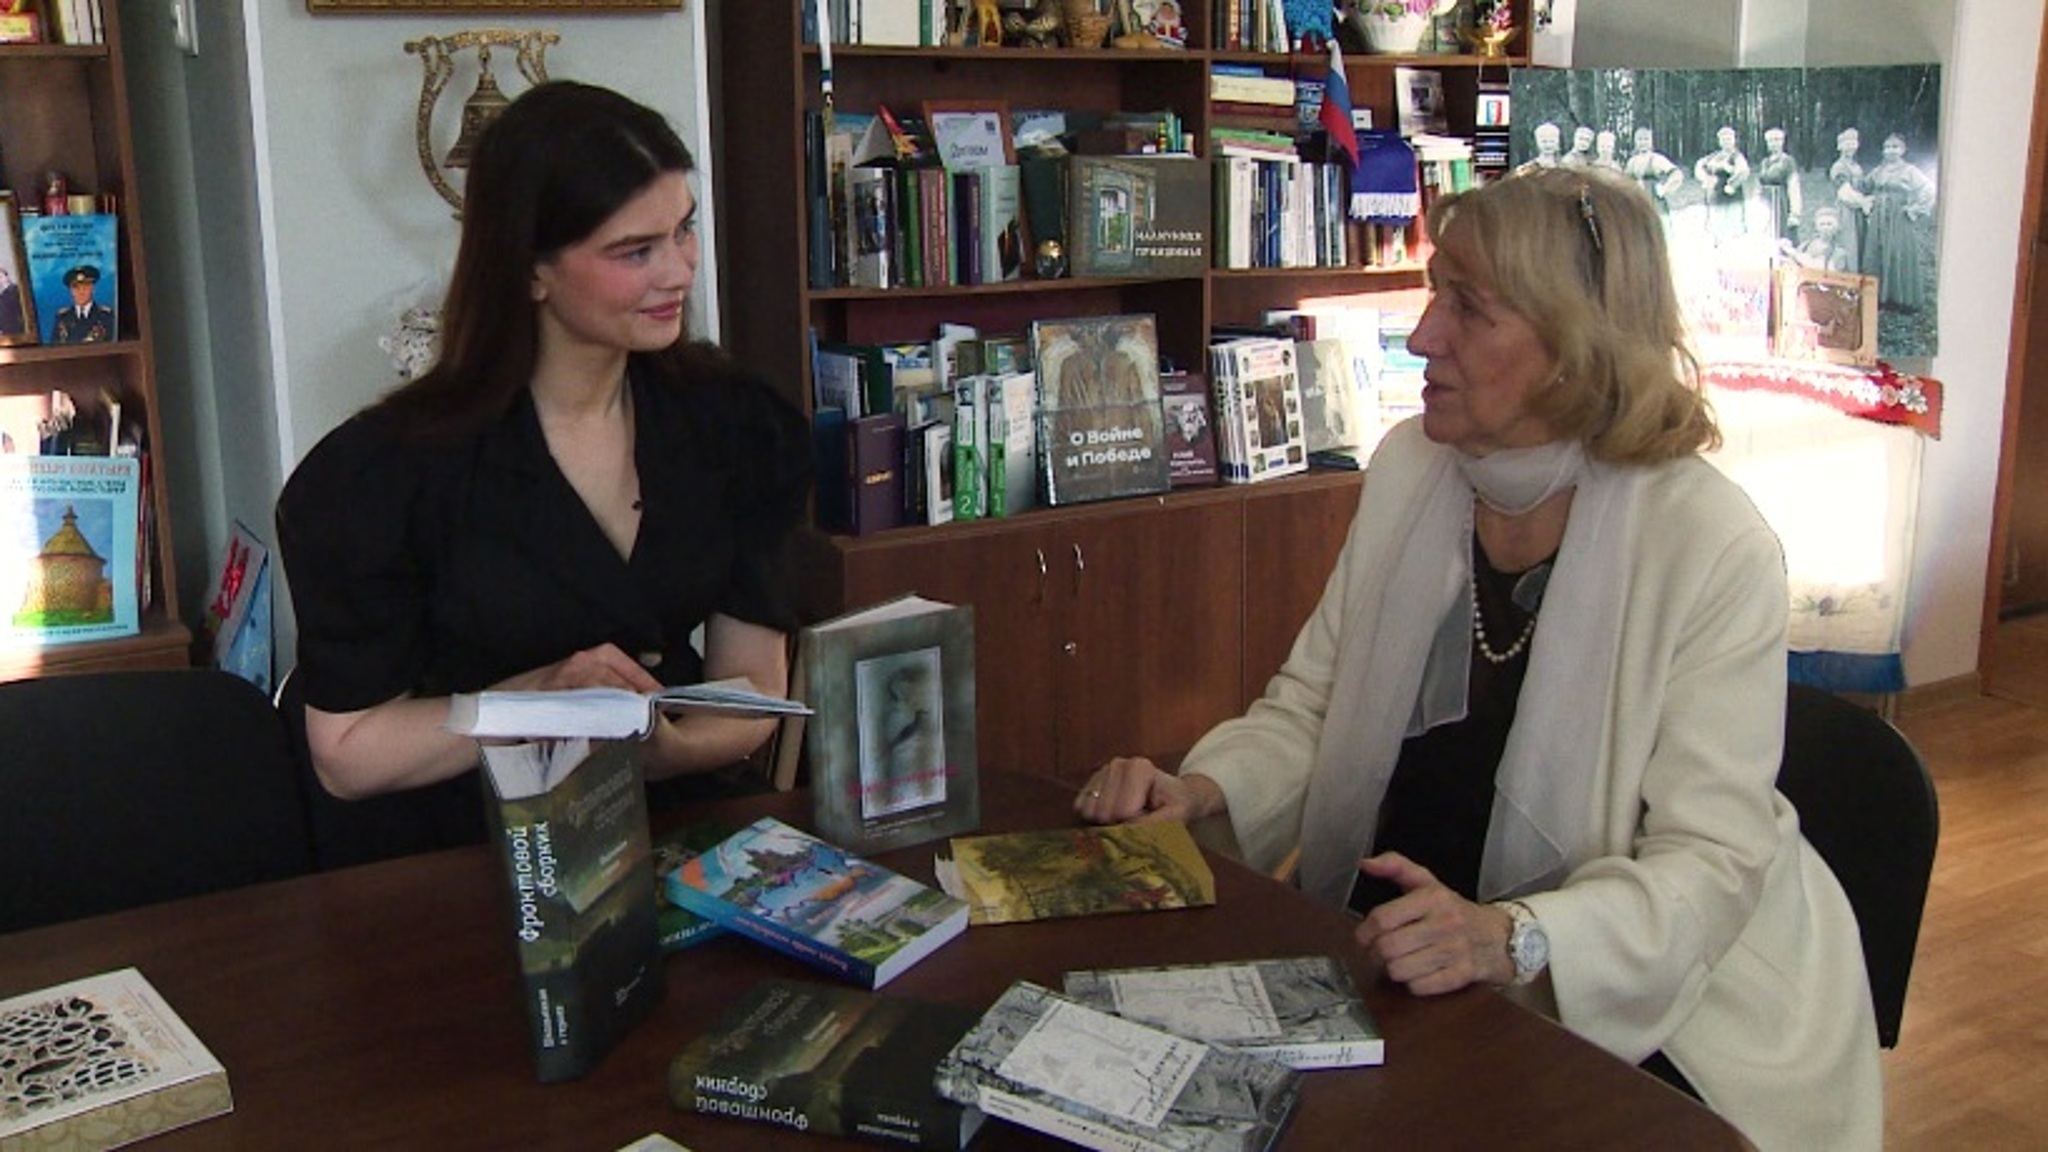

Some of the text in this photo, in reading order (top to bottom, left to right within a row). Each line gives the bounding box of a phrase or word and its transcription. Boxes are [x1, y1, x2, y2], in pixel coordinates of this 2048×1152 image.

[1070, 425, 1144, 446] О Войне
[1065, 455, 1079, 468] и
[1082, 447, 1152, 467] Победе
[959, 495, 971, 514] 2
[535, 820, 559, 898] сборник
[505, 825, 540, 943] Фронтовой
[694, 1074, 769, 1102] сборник
[695, 1095, 810, 1131] Фронтовой
